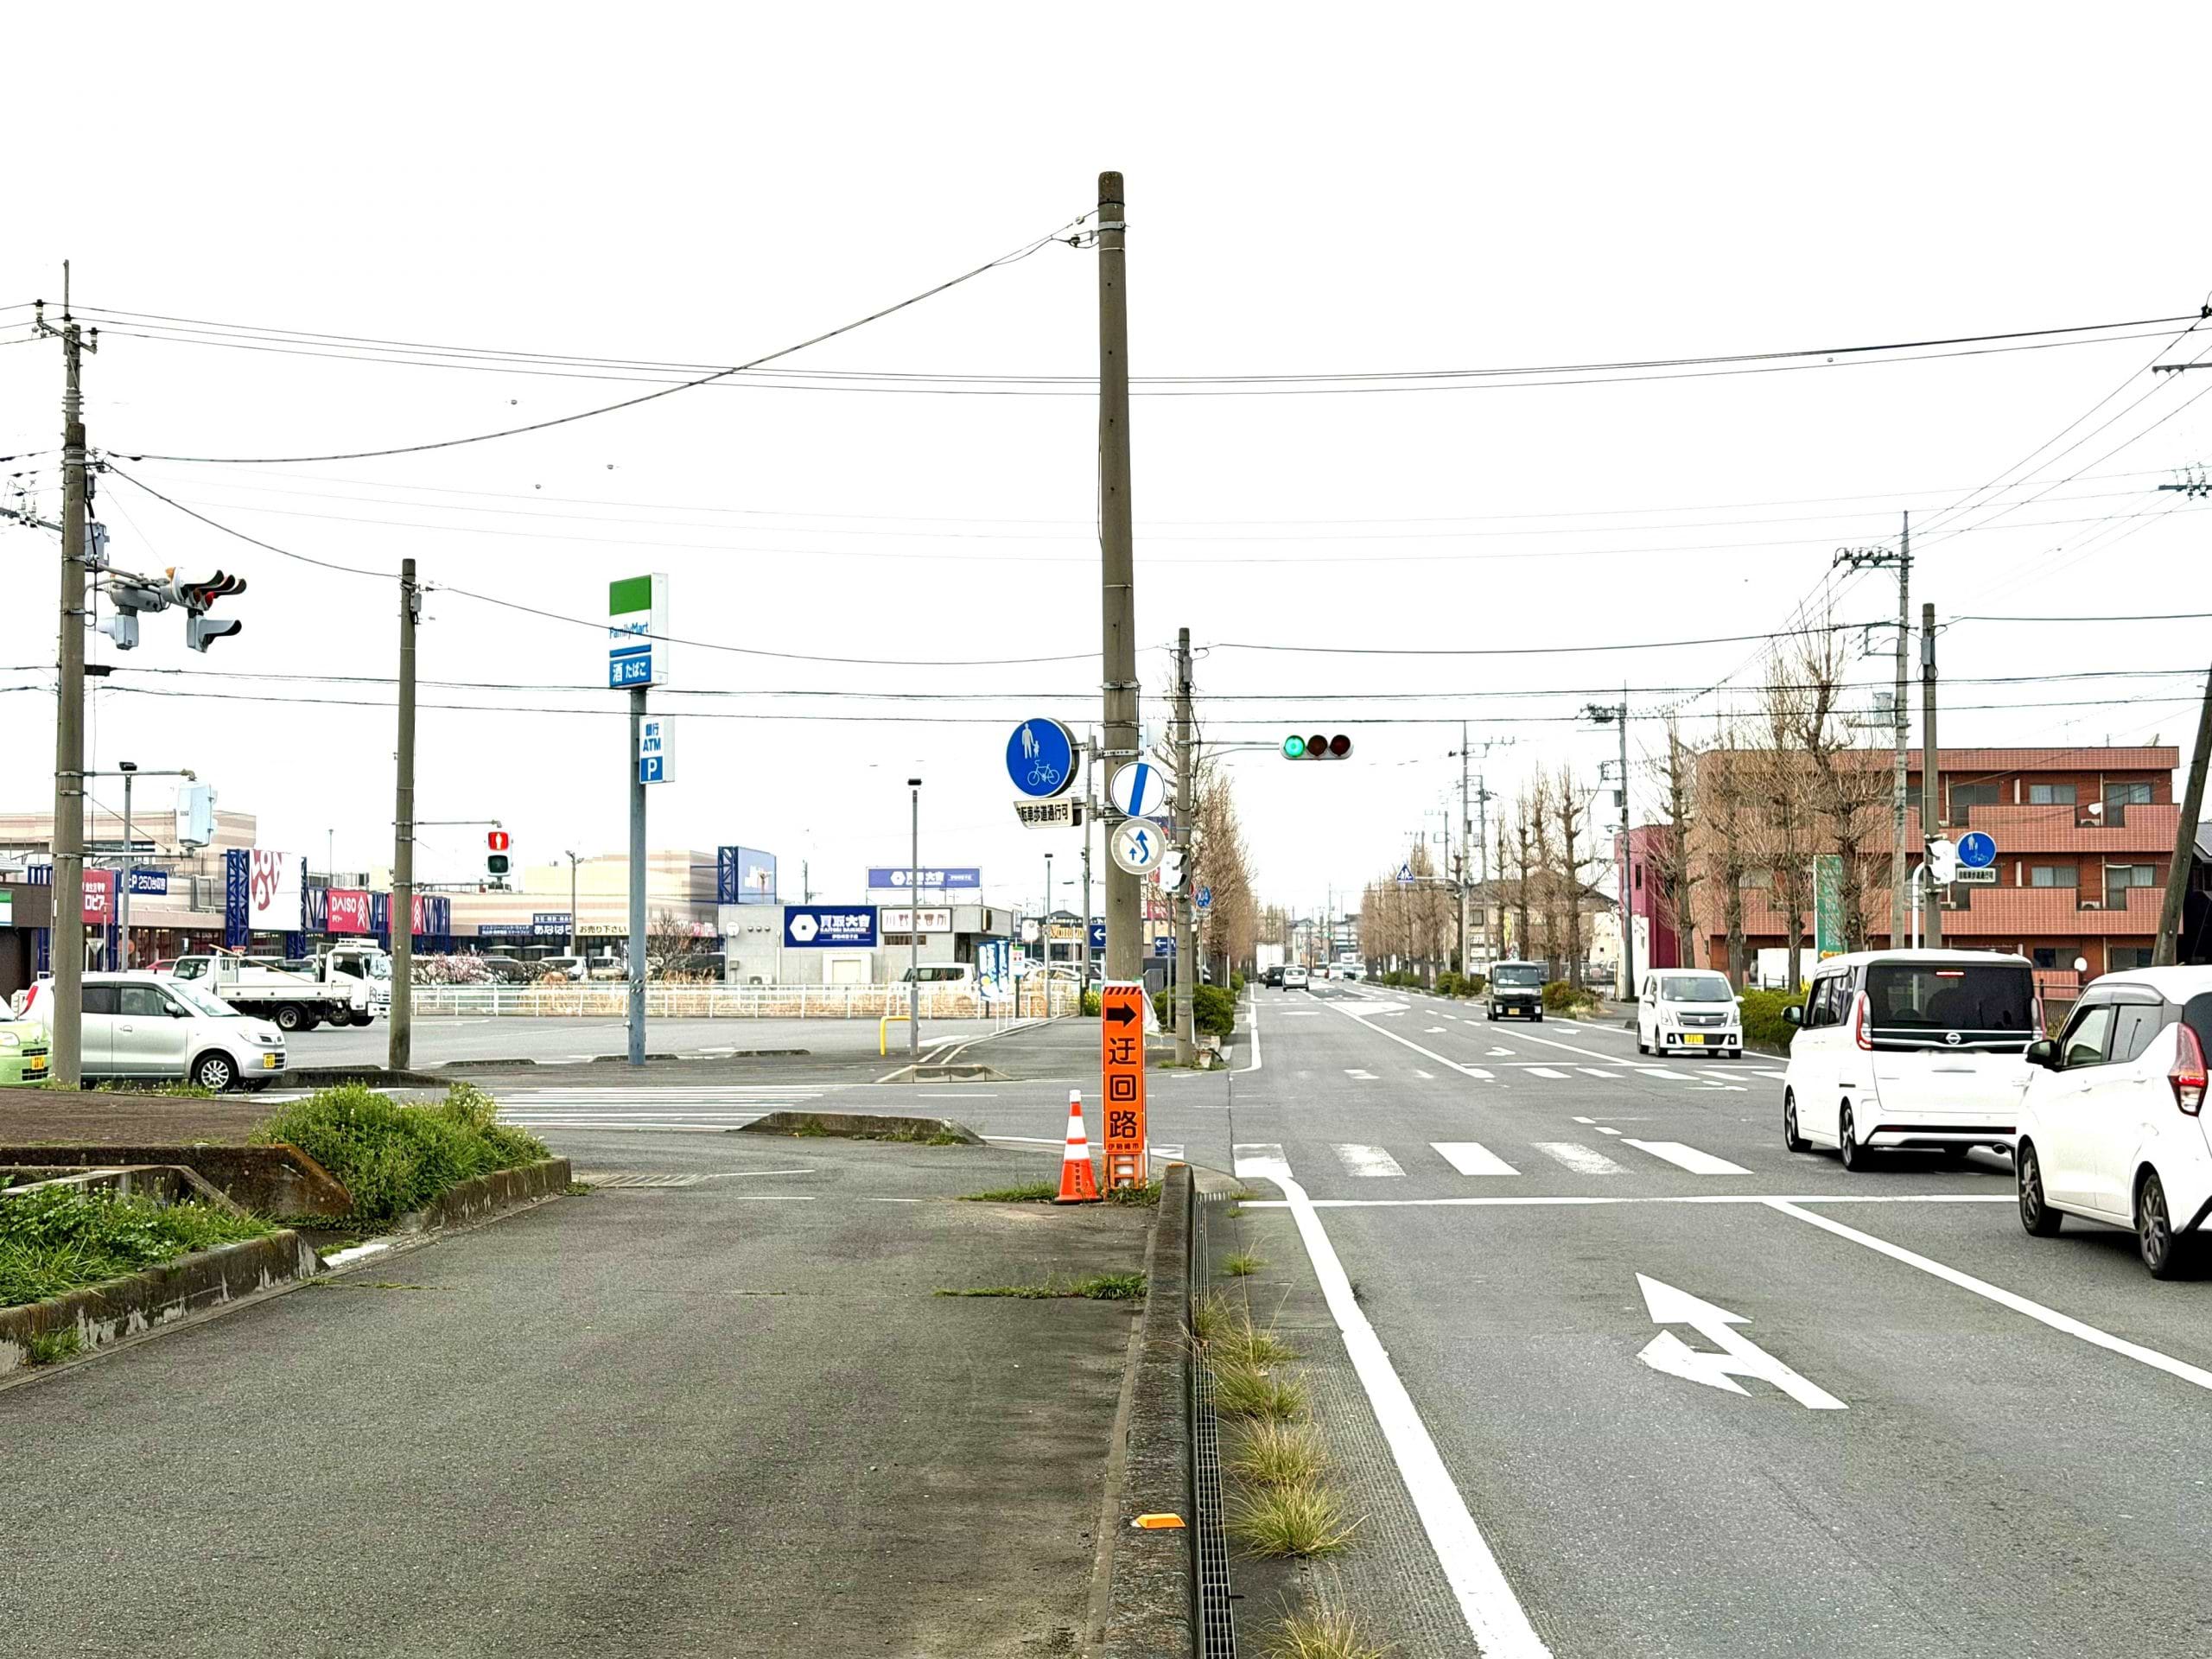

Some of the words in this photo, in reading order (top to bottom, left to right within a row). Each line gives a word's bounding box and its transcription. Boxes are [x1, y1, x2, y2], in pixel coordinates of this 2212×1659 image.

[609, 621, 649, 639] FamilyMart
[613, 663, 623, 683] 酒
[626, 662, 646, 678] たばこ
[645, 722, 659, 737] 銀行
[642, 737, 661, 753] ATM
[647, 759, 658, 779] P
[85, 894, 105, 911] ロピア
[332, 896, 356, 912] DAISO
[1108, 1037, 1137, 1138] 迂回路
